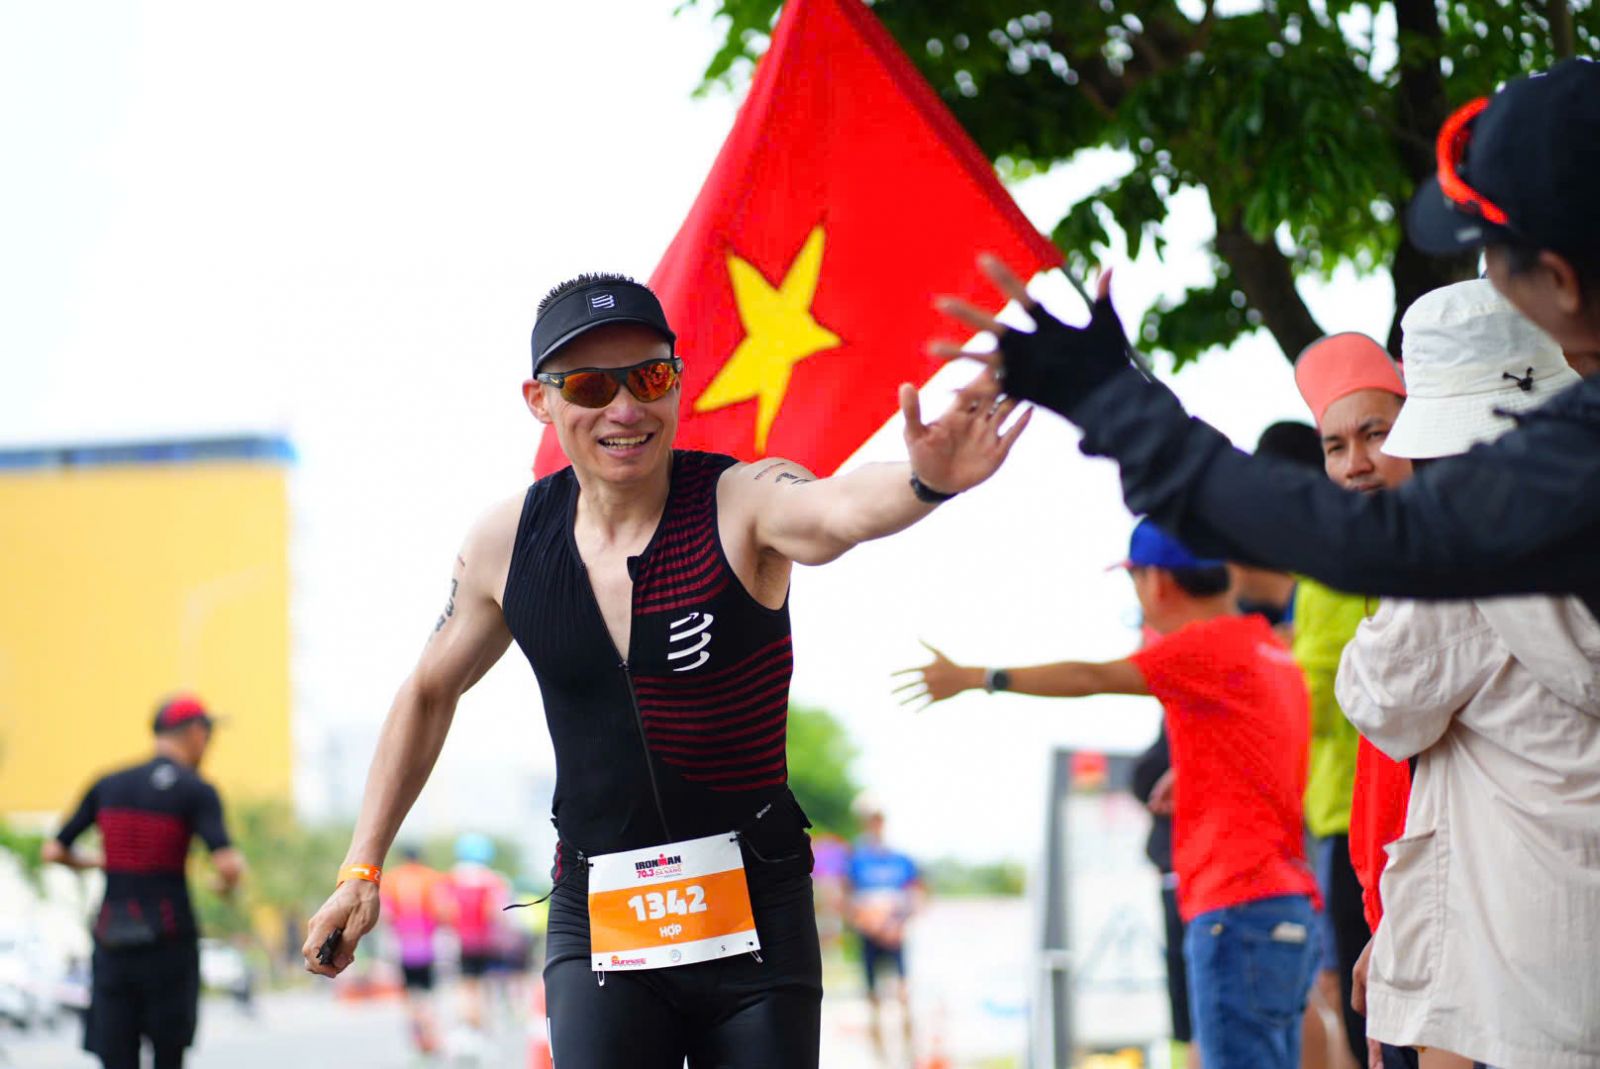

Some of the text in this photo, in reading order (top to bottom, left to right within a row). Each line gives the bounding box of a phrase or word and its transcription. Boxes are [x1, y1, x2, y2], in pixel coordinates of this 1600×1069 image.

[635, 853, 682, 870] IRONMAN
[636, 868, 655, 878] 70.3
[627, 885, 708, 922] 1342
[721, 944, 726, 952] S
